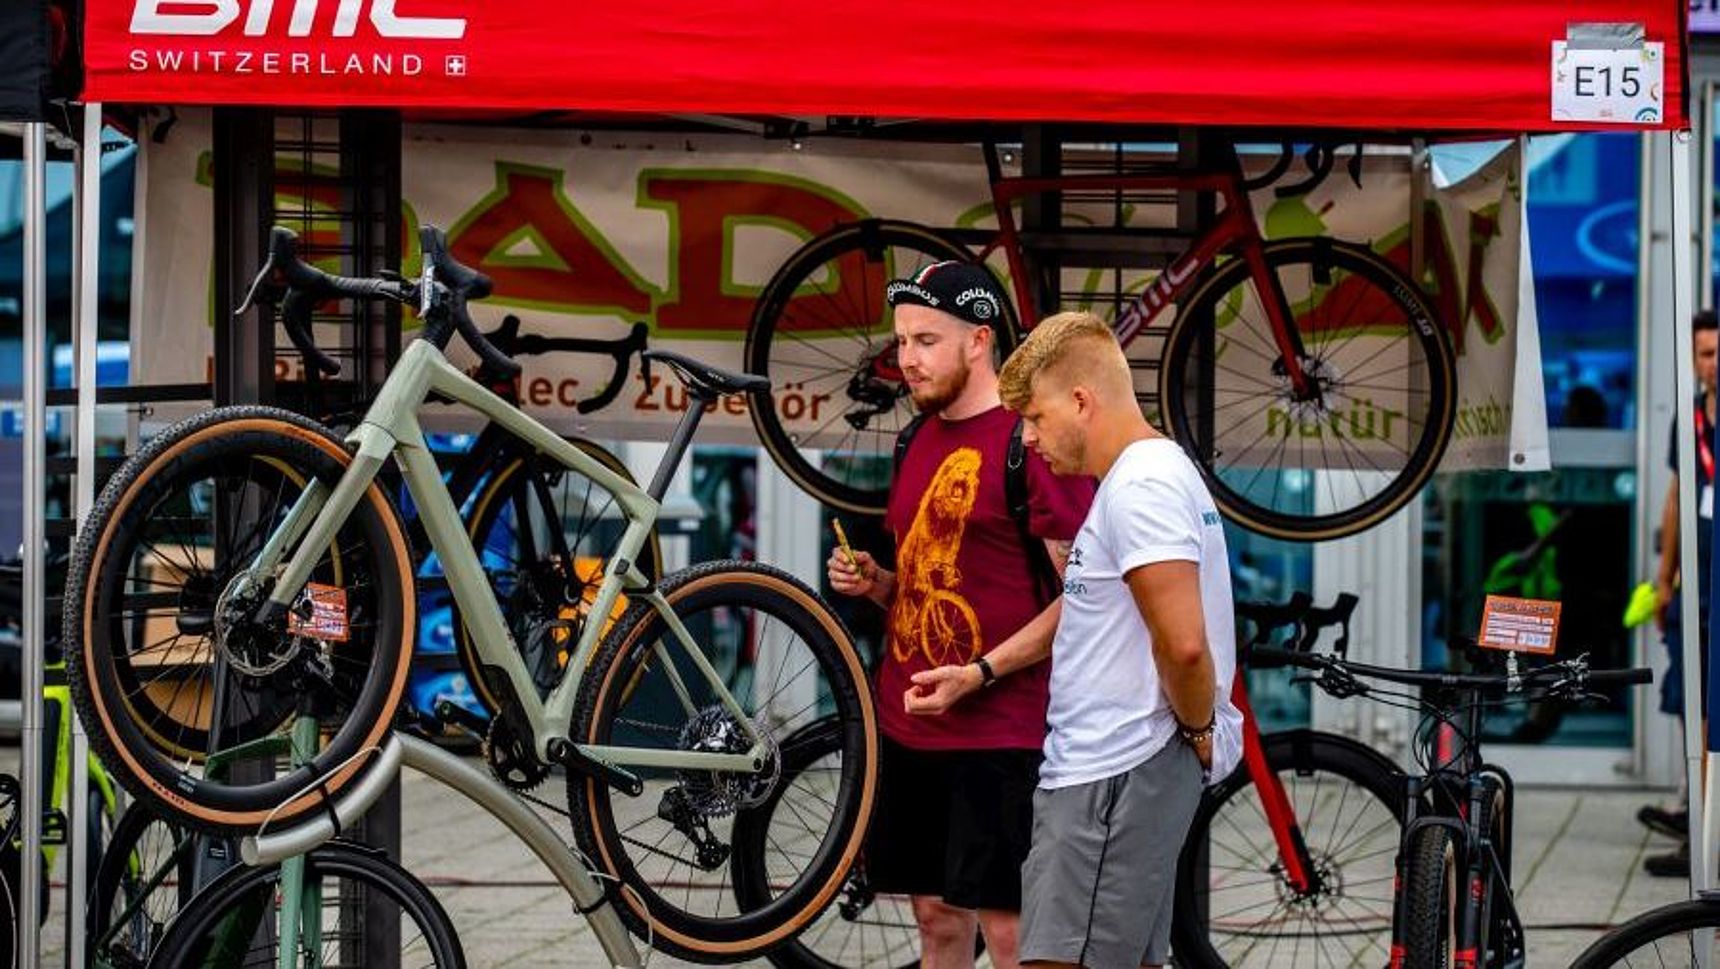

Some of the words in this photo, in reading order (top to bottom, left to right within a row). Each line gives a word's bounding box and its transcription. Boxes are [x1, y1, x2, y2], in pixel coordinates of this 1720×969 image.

[129, 0, 467, 39] BMC
[129, 50, 422, 76] SWITZERLAND
[1575, 66, 1641, 97] E15
[634, 372, 831, 422] Zueör
